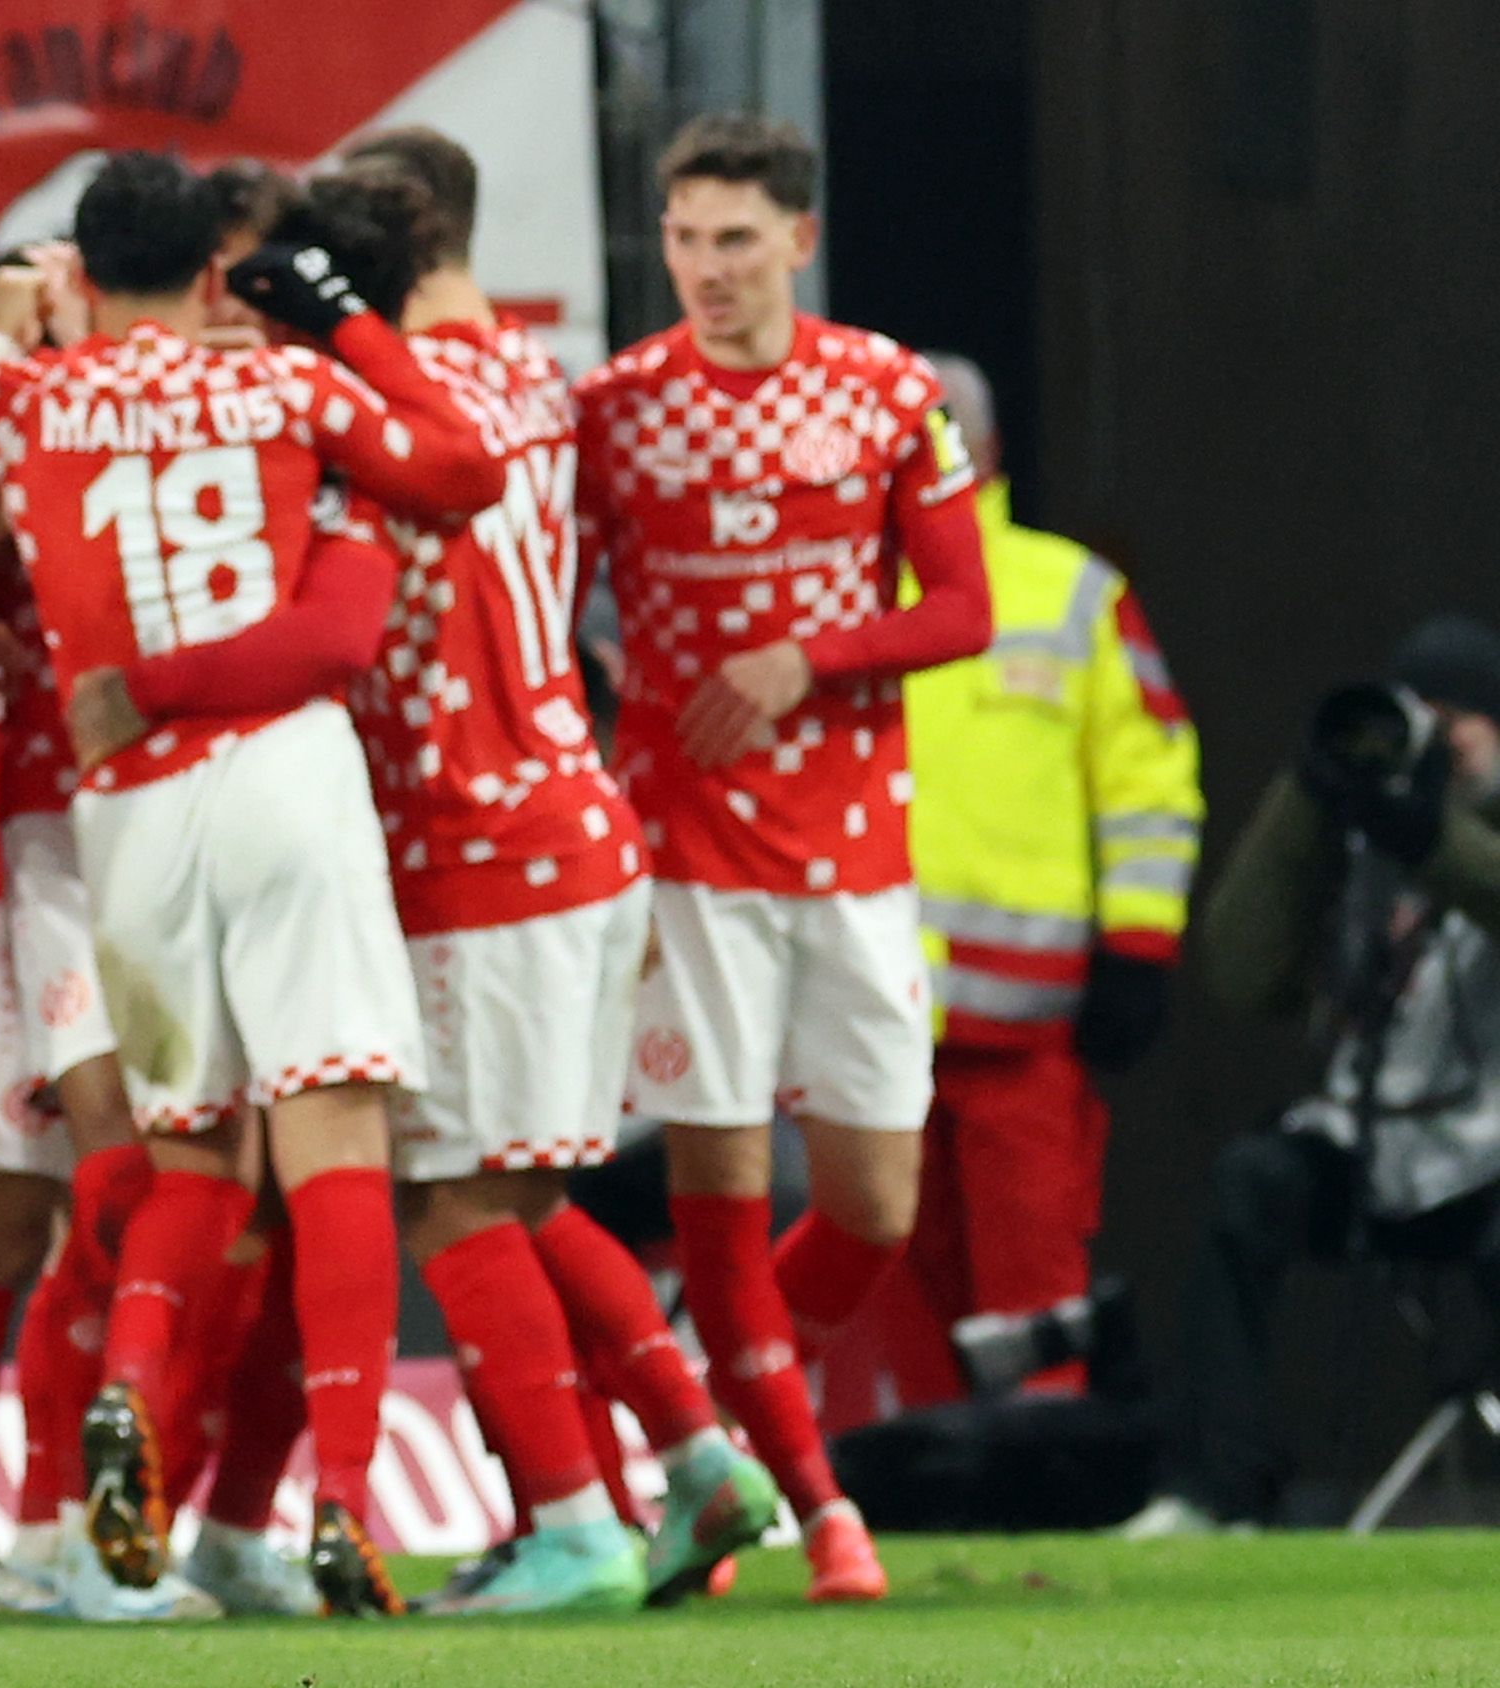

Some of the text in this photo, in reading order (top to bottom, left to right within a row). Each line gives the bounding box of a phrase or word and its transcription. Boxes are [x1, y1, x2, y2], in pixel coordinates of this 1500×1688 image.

[40, 386, 285, 454] MAINZ 05
[82, 446, 277, 659] 18
